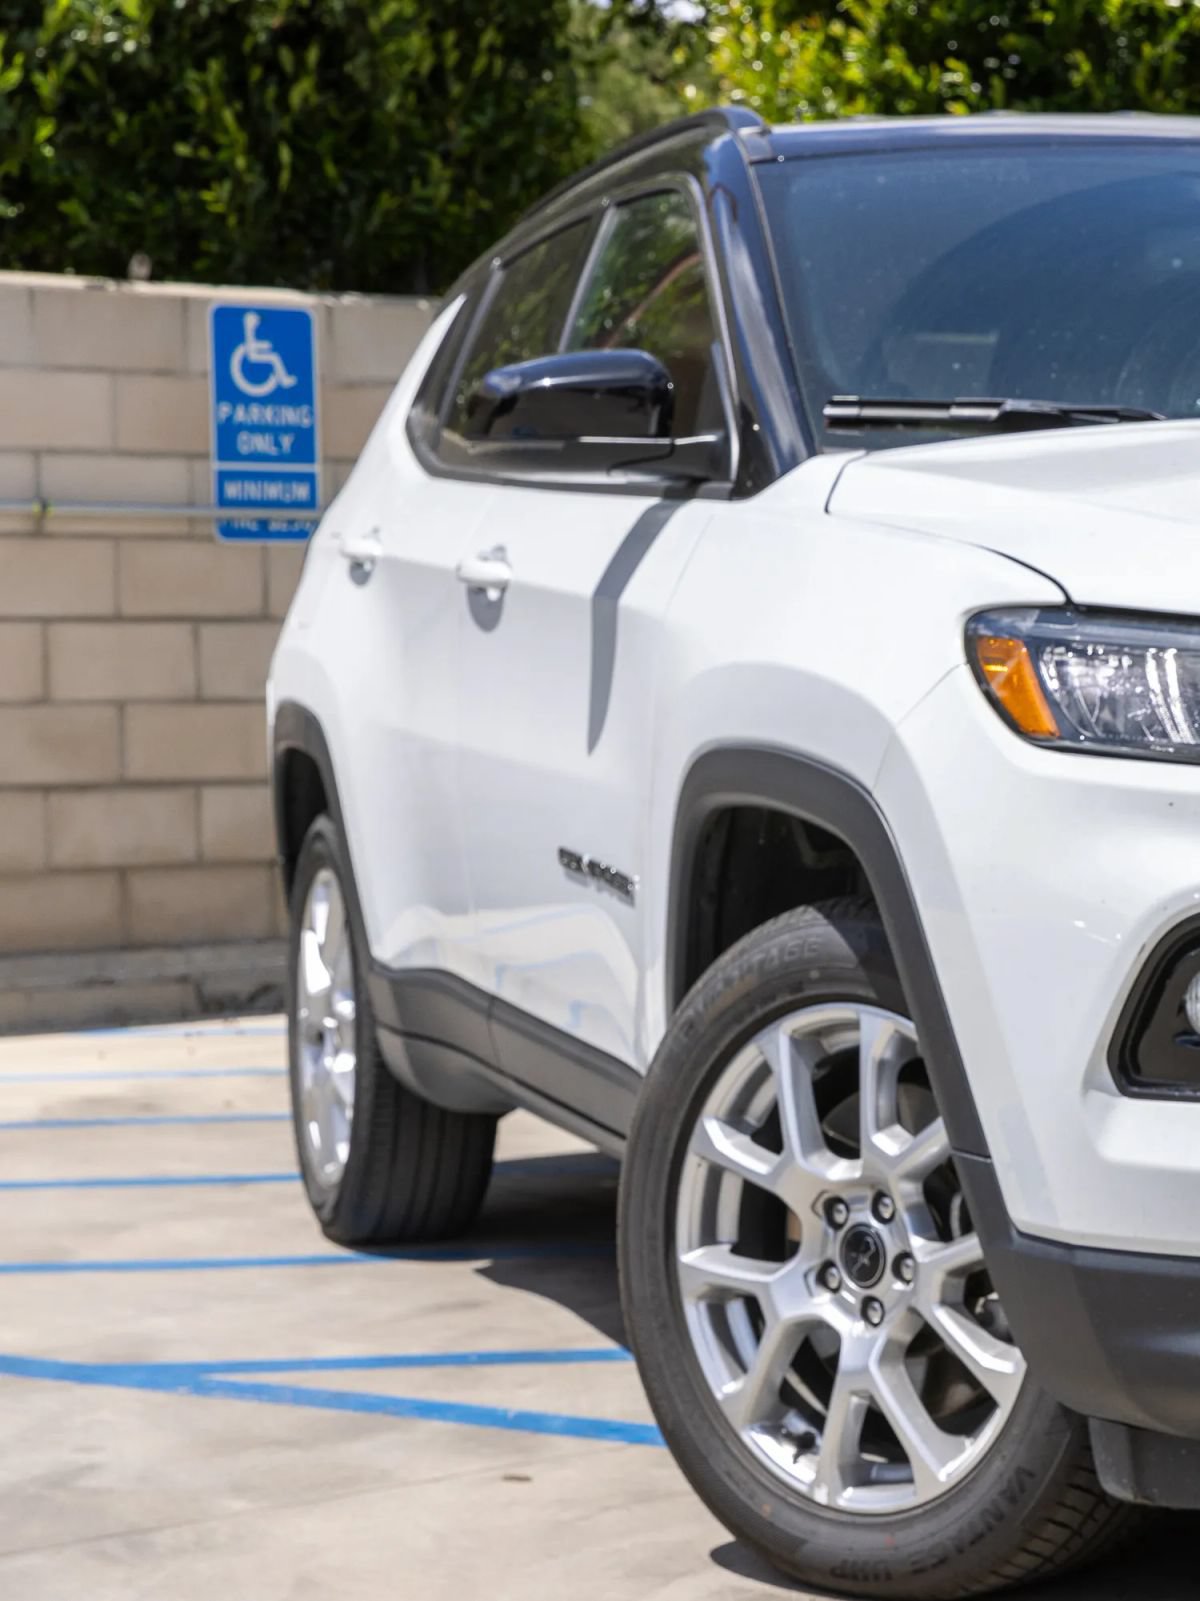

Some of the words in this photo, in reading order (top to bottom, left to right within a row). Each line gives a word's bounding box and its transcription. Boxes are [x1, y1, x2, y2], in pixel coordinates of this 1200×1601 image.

[218, 402, 312, 428] PARKING
[237, 430, 294, 456] ONLY
[224, 479, 310, 502] MINIMUM
